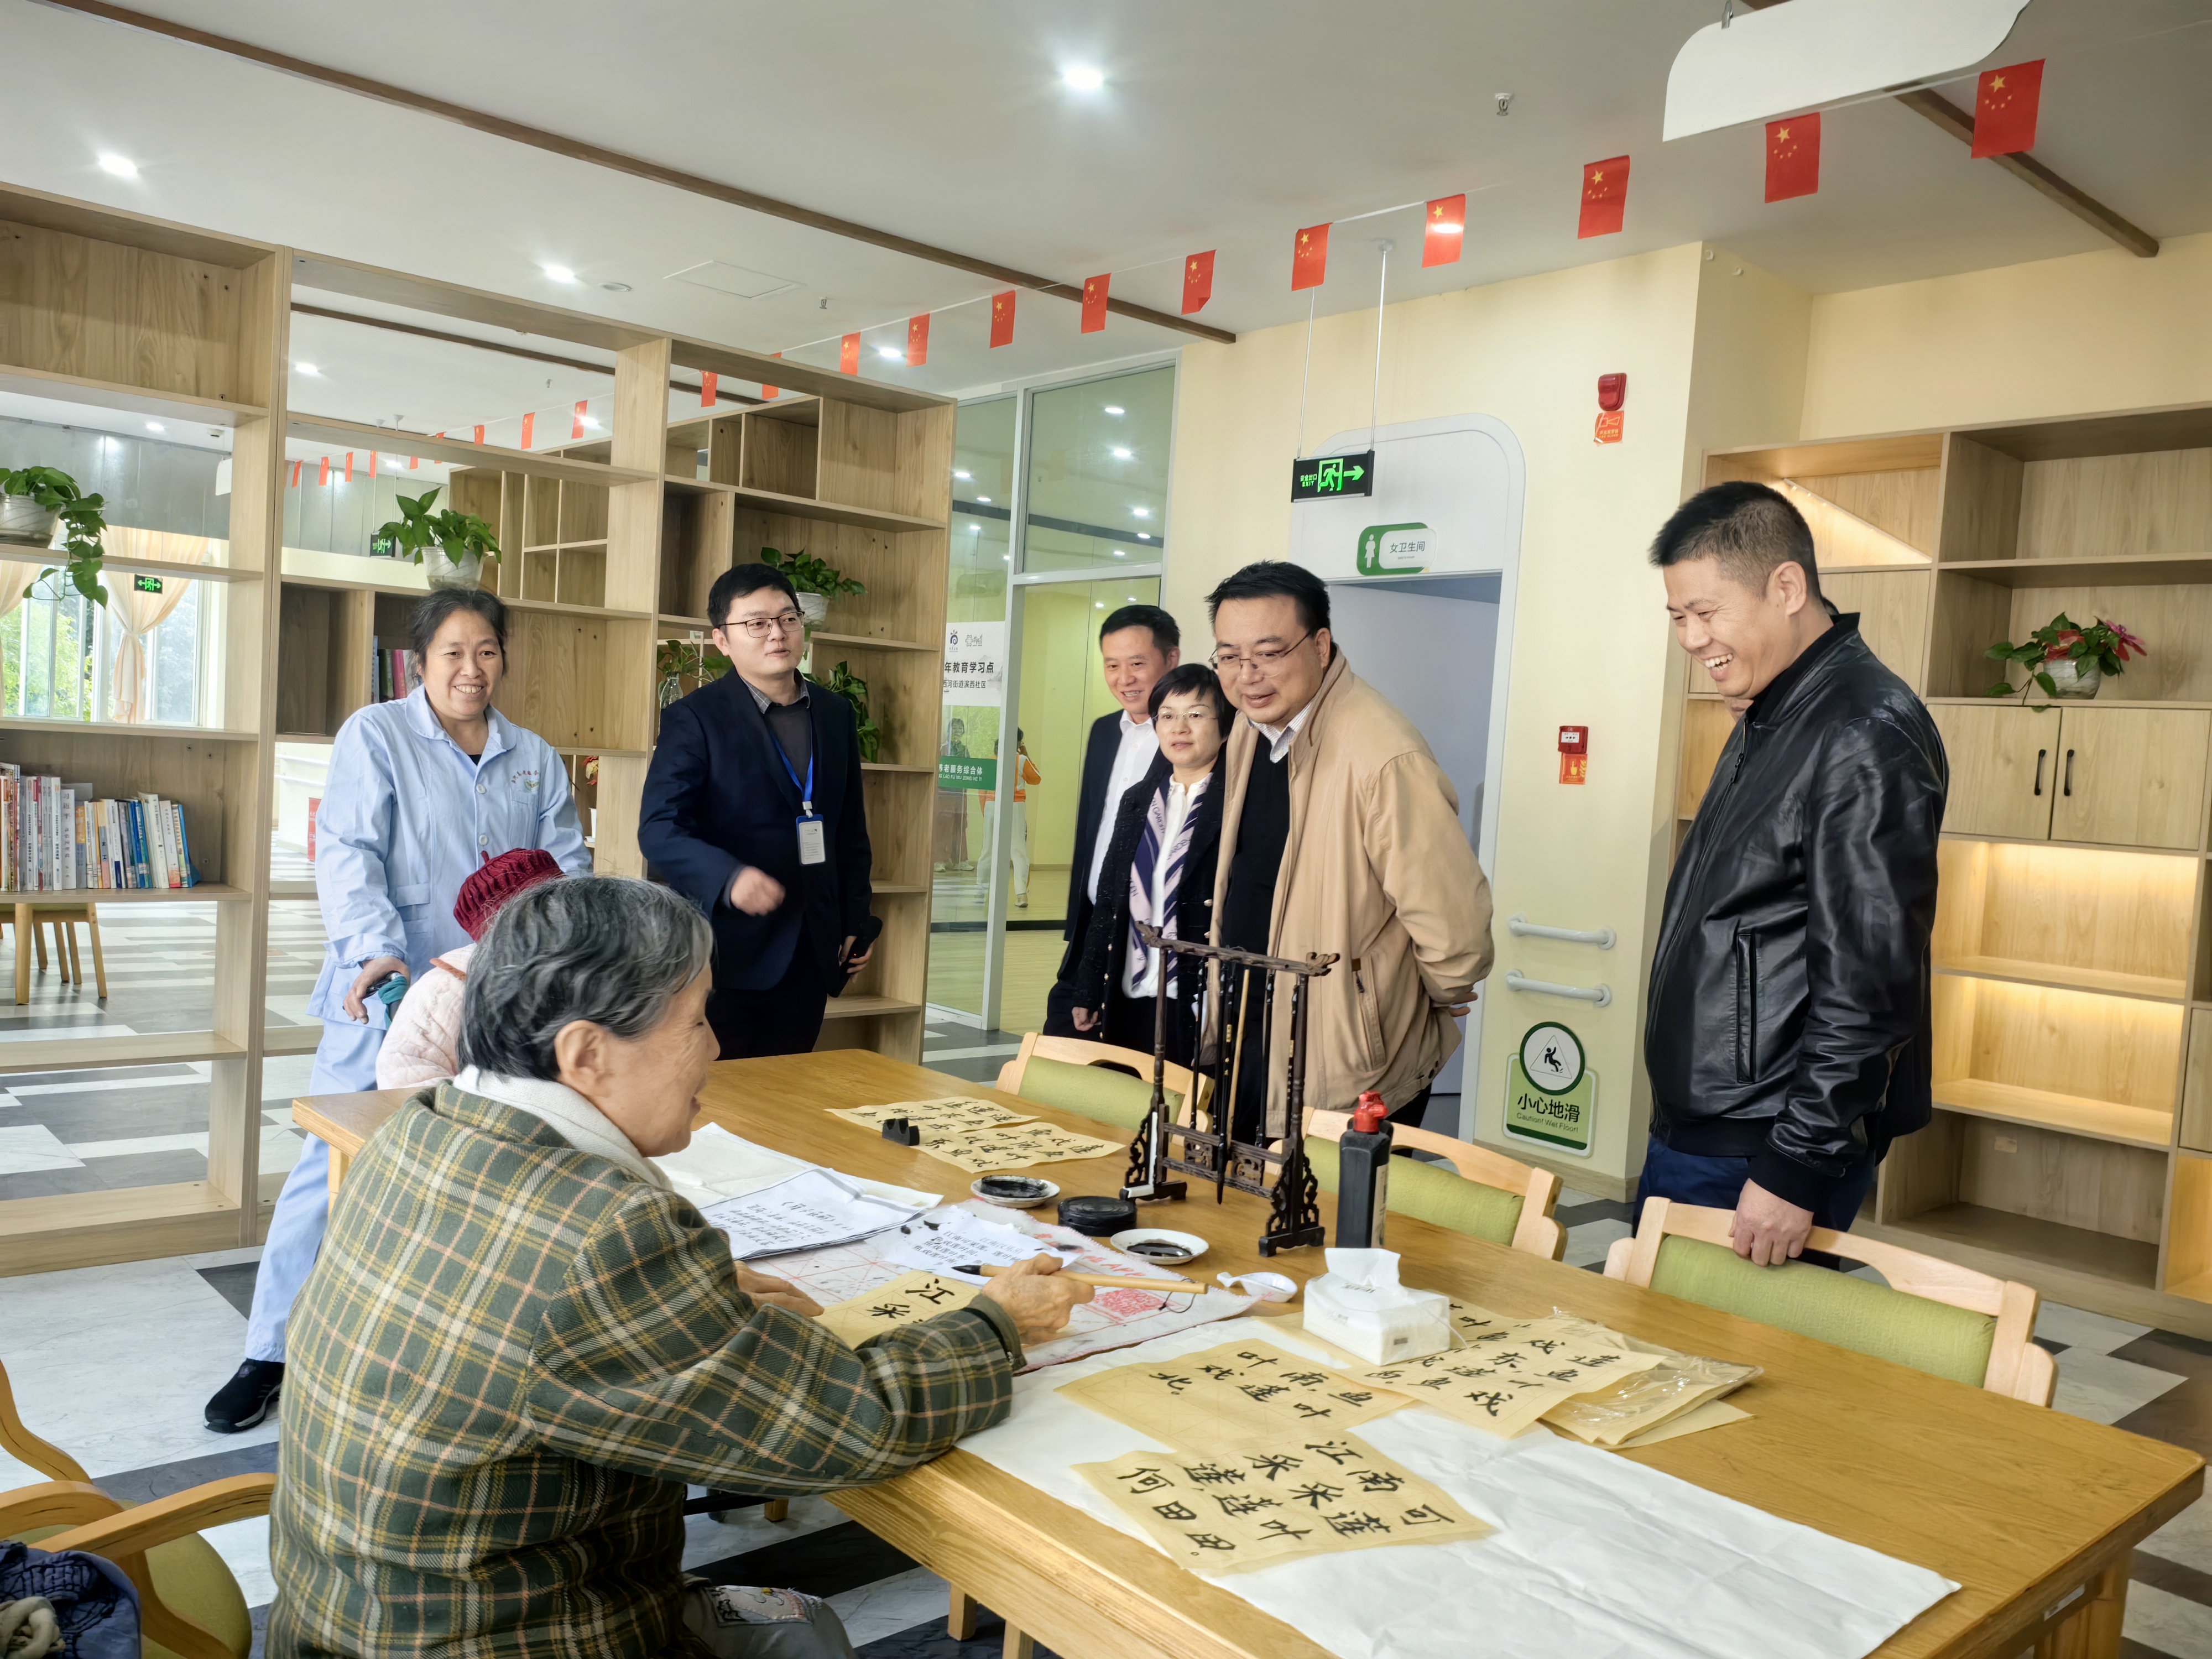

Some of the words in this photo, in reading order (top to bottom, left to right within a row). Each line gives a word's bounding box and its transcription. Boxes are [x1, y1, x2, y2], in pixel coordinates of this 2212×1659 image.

[1300, 473, 1318, 482] 安全出口
[1389, 541, 1426, 554] 女卫生间
[945, 661, 994, 674] 年教育学习点
[1517, 1093, 1580, 1122] 小心地滑
[1545, 1119, 1558, 1129] Wet
[905, 1278, 955, 1305] 江
